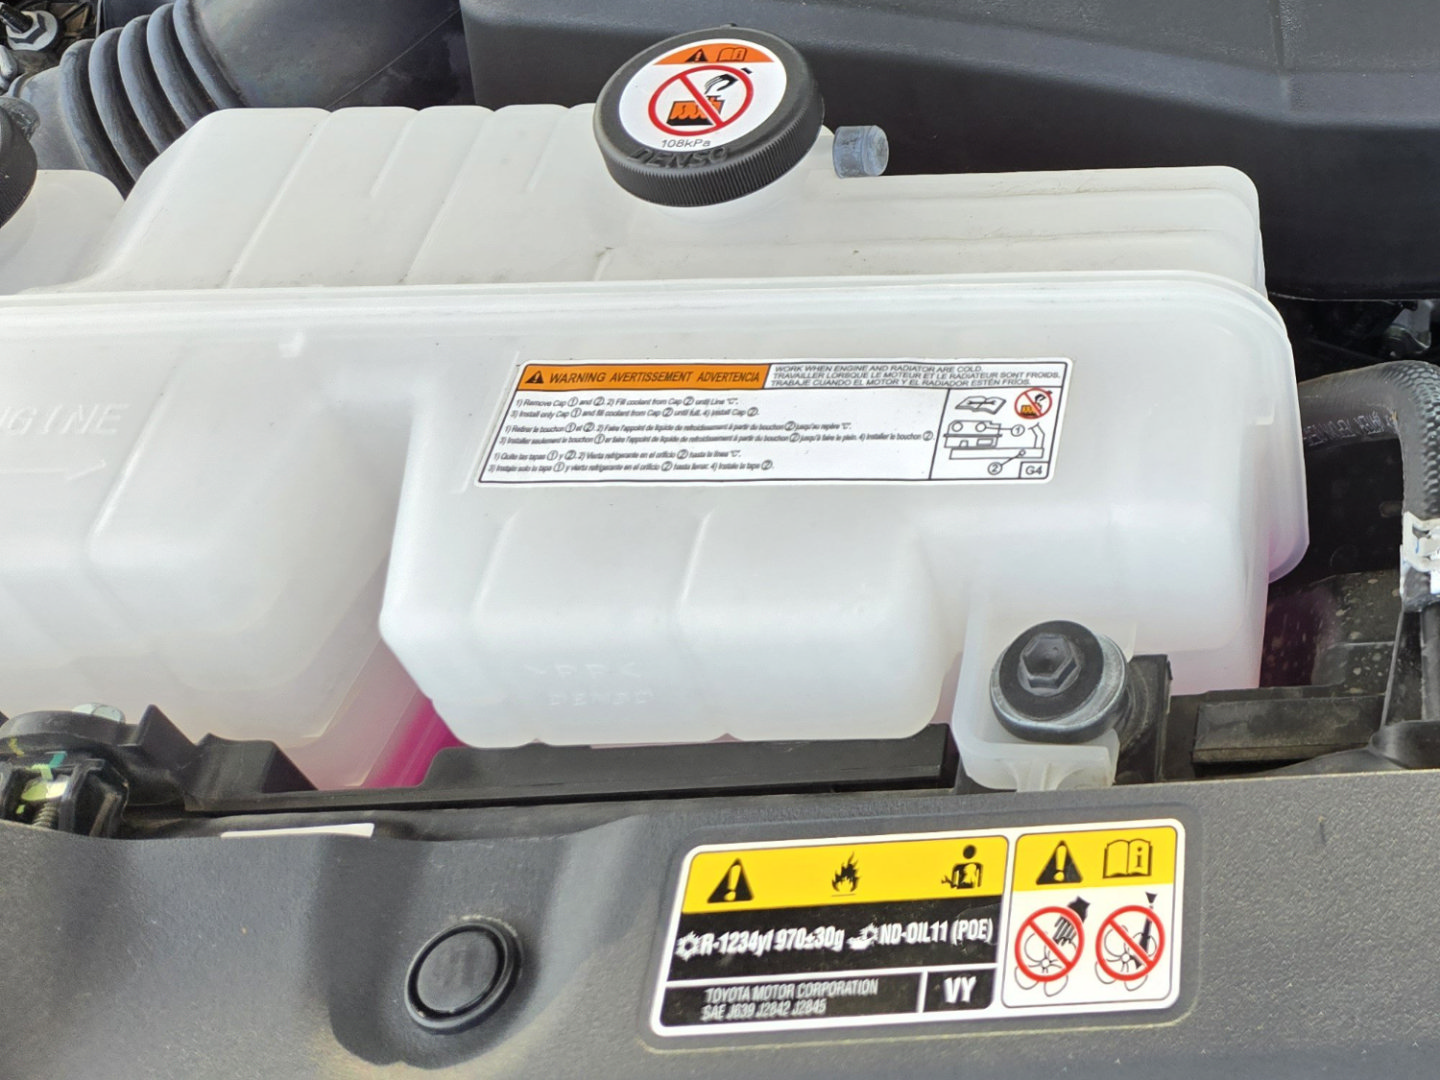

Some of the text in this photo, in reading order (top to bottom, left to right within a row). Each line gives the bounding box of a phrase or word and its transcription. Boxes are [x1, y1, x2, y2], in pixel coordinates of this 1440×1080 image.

[661, 138, 711, 148] 108kPa
[627, 146, 729, 168] DENSO
[549, 371, 760, 383] WARNING AVERTISSEMENT ADVERTENCIA
[523, 398, 552, 406] Remove
[553, 399, 567, 407] Cap
[668, 398, 683, 406] Cap
[1025, 466, 1043, 475] G4
[773, 925, 845, 952] 970±30g
[877, 920, 949, 945] ND-OIL11
[951, 918, 993, 946] (POE)
[703, 978, 879, 1004] TOYOTA MOTOR CORPORATION
[943, 976, 977, 1004] VY
[701, 998, 827, 1021] SAE J639 J2842 J2845
